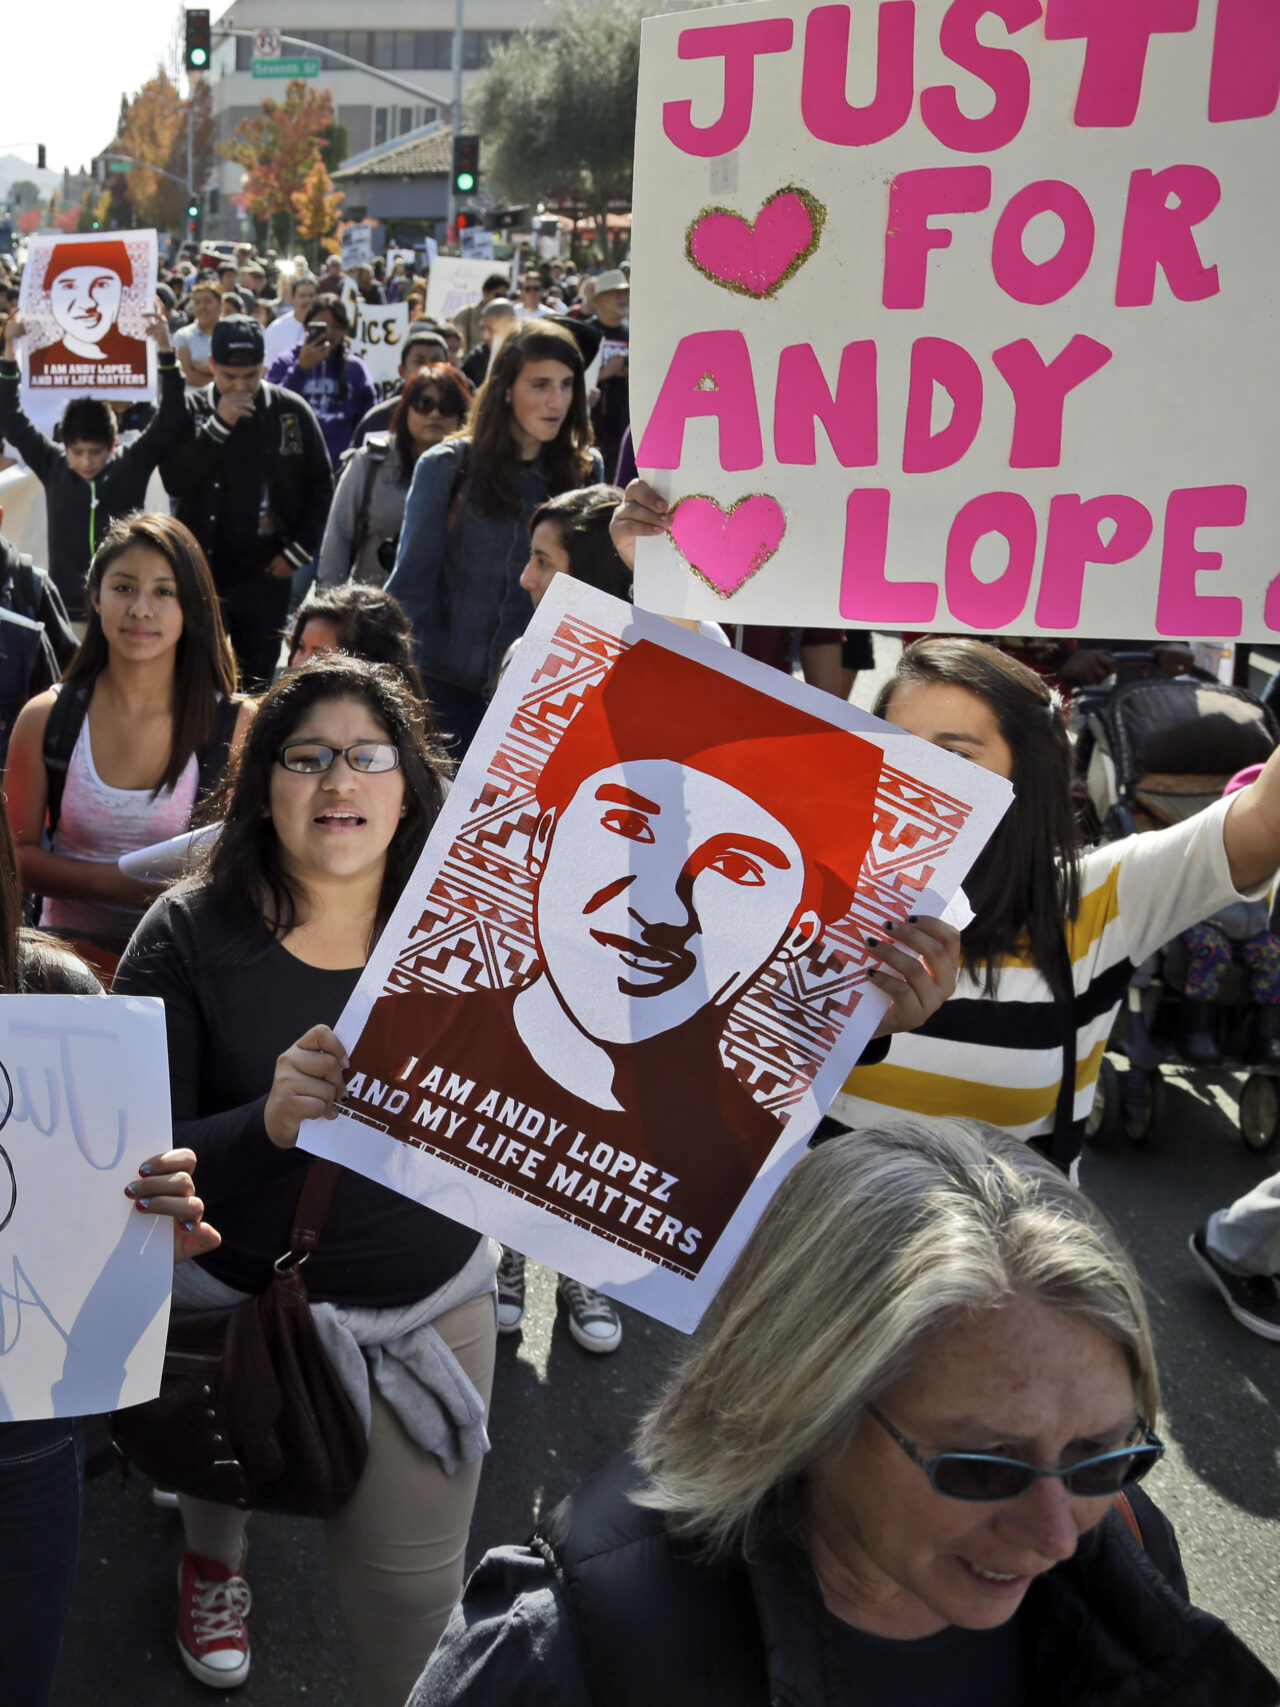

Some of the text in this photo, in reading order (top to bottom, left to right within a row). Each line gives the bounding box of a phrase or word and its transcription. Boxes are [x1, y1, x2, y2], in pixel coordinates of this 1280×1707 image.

[882, 164, 1222, 310] FOR
[31, 374, 145, 385] AND MY LIFE MATTERS
[50, 364, 67, 374] AM
[68, 363, 96, 375] ANDY
[97, 363, 132, 374] LOPEZ
[634, 329, 1113, 473] ANDY
[839, 485, 1280, 636] LOPE
[345, 1071, 409, 1115] AND
[411, 1098, 468, 1140] MY
[466, 1123, 548, 1178] LIFE
[545, 1163, 703, 1256] MATTERS
[400, 1056, 418, 1081] I
[419, 1065, 477, 1106] AM
[474, 1089, 568, 1148] ANDY
[568, 1131, 679, 1203] LOPEZ
